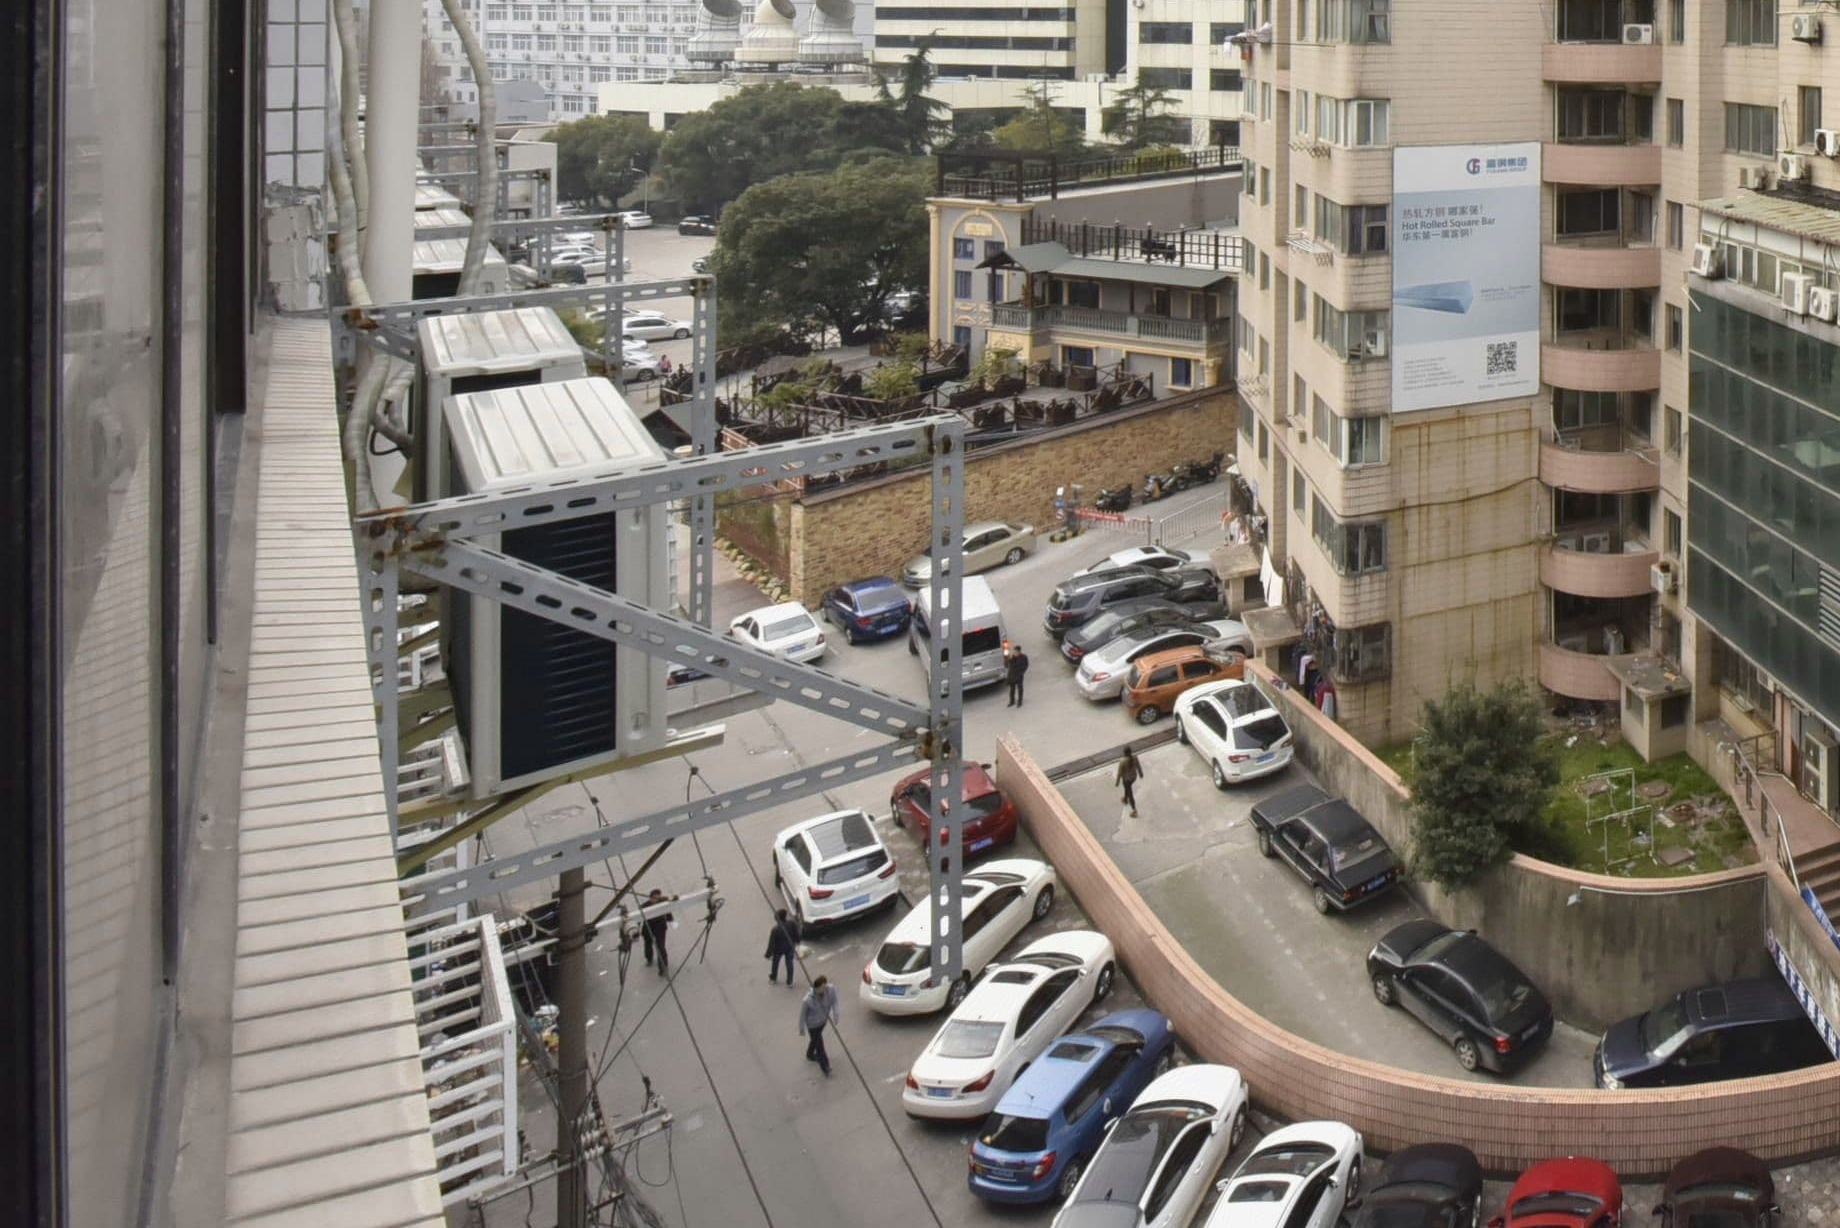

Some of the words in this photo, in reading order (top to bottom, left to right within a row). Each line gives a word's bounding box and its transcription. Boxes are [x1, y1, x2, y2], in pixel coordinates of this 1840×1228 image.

[1402, 221, 1418, 231] Hot
[1420, 219, 1448, 229] Rolled
[1449, 218, 1480, 228] Square
[1481, 216, 1496, 226] Bar
